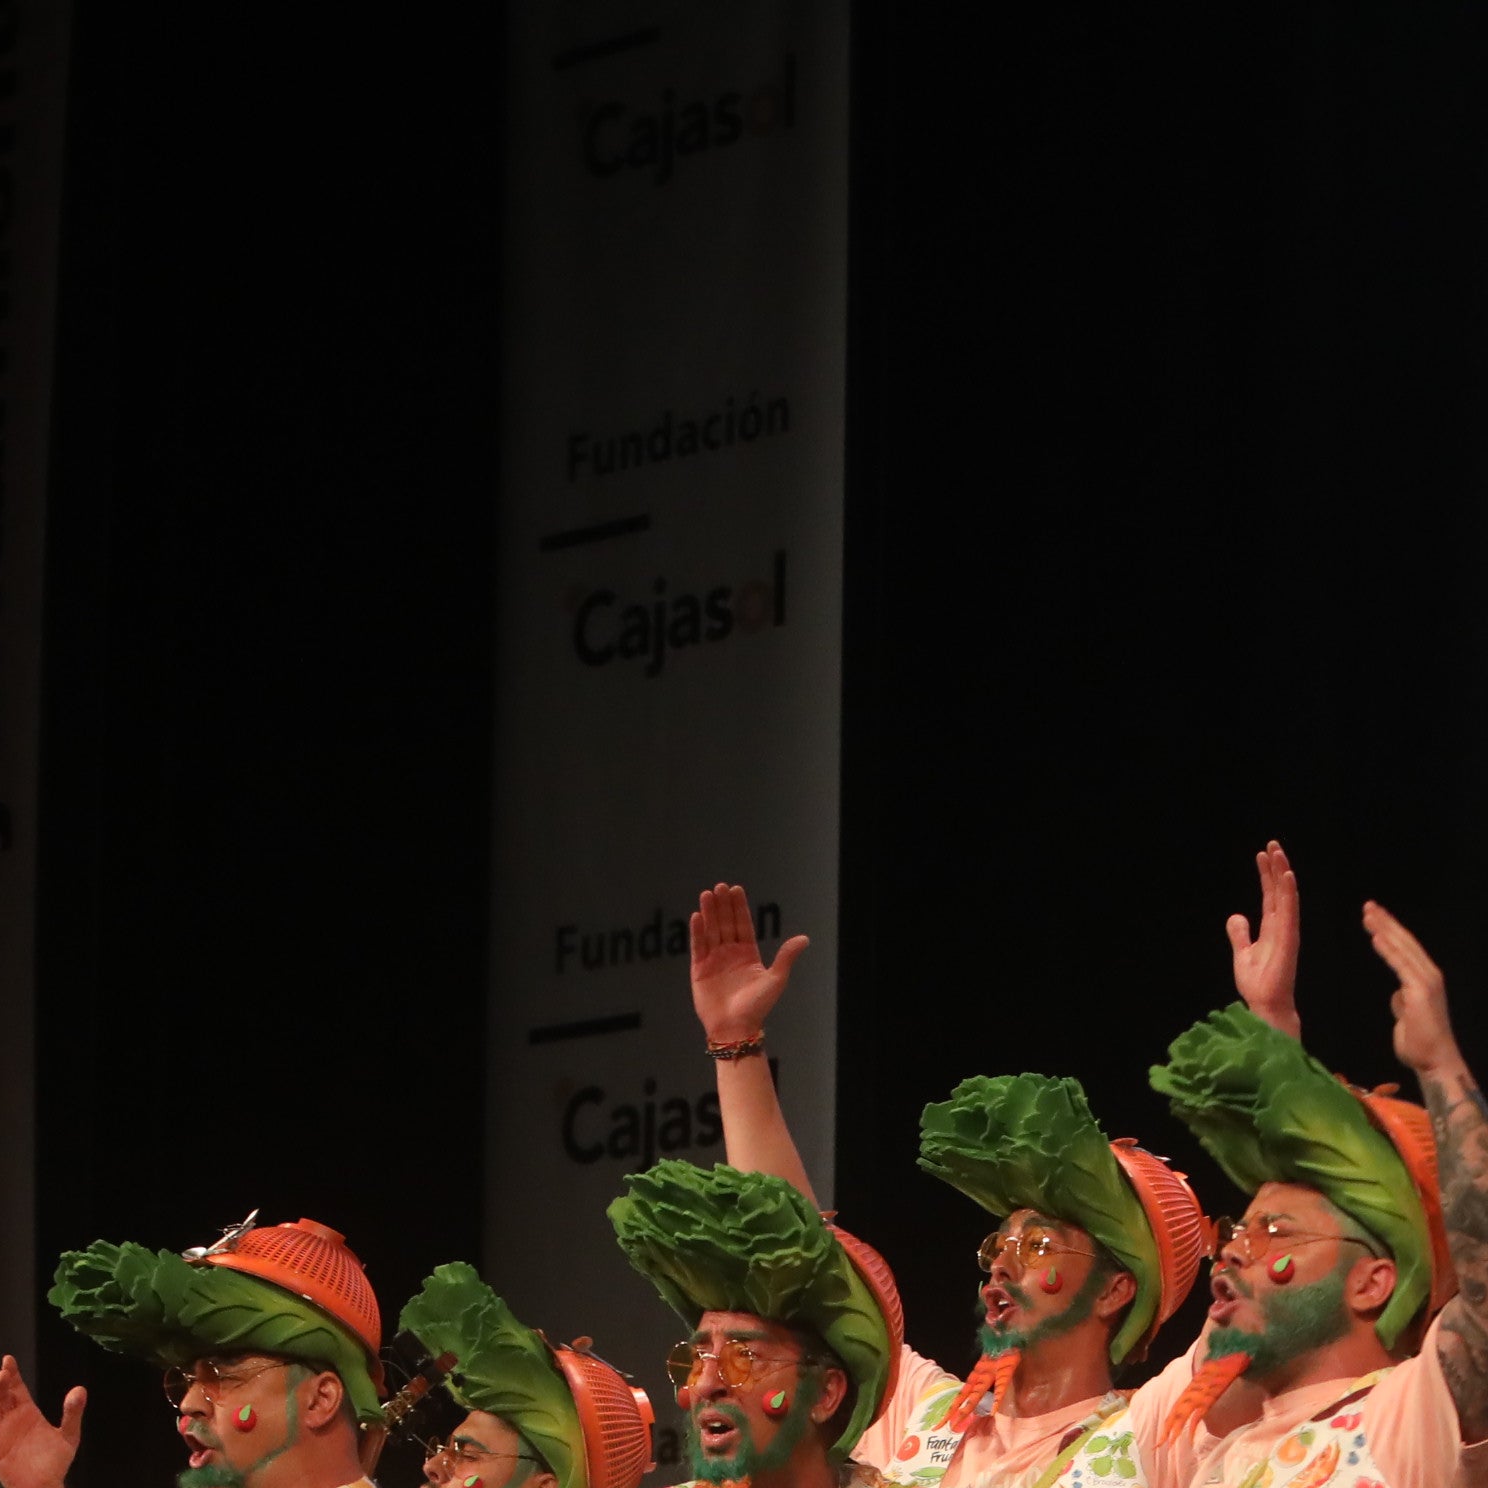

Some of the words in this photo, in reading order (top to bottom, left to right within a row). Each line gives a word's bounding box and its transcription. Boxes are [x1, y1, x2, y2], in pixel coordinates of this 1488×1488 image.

[582, 53, 796, 187] Cajasol
[566, 389, 791, 483] Fundación
[572, 548, 787, 678] Cajasol
[554, 900, 781, 975] Fundan
[561, 1057, 778, 1170] Cajas
[926, 1435, 959, 1451] Fanta
